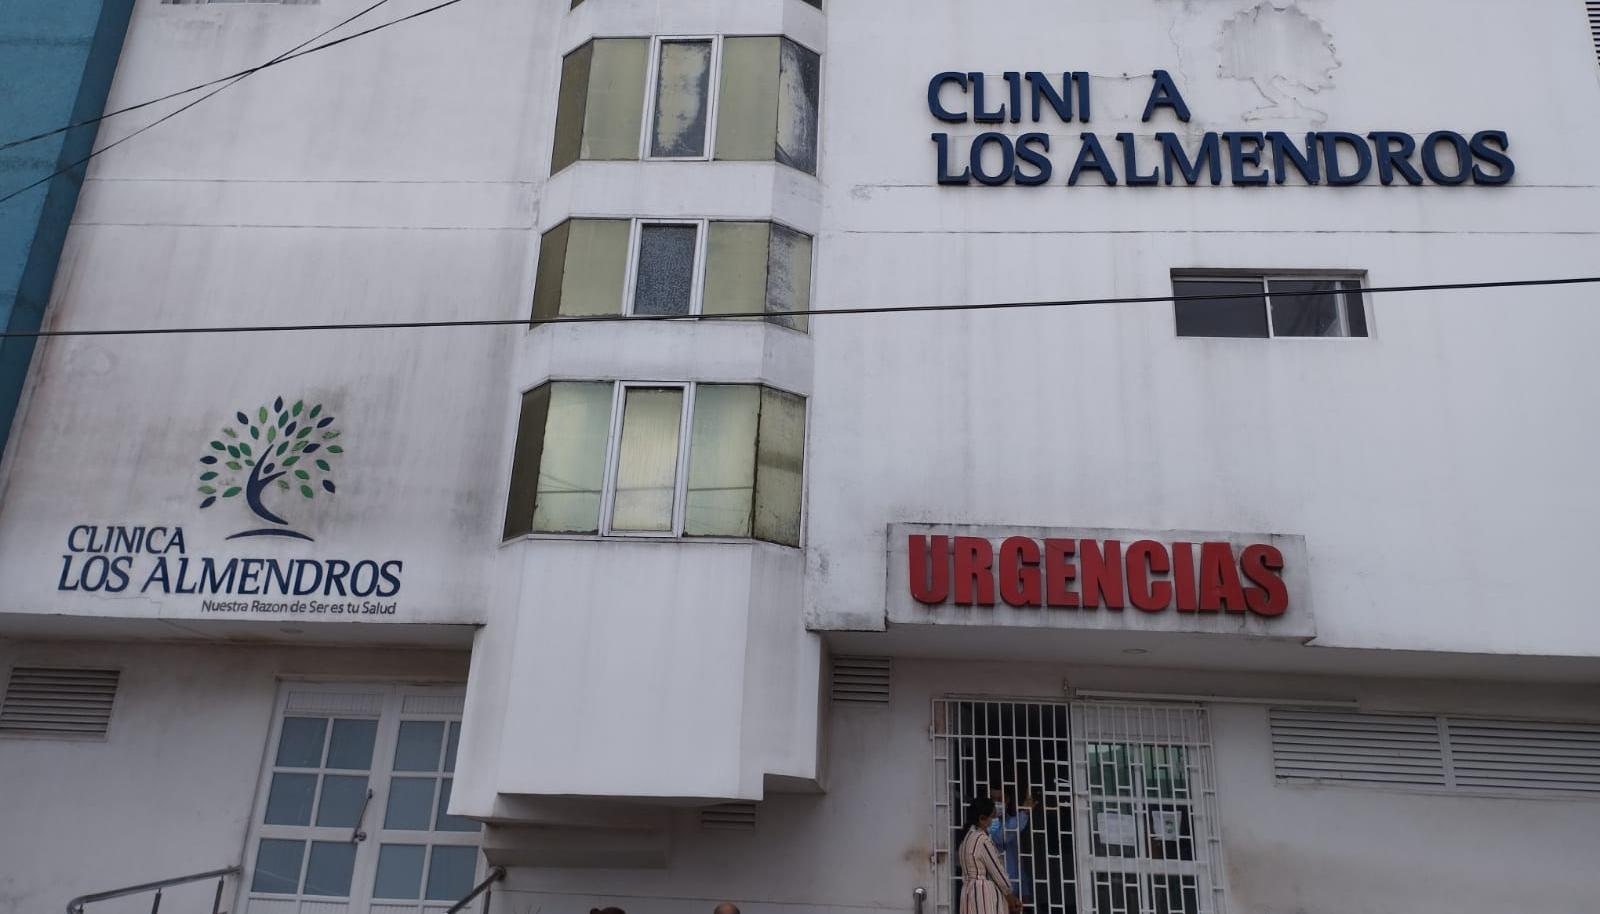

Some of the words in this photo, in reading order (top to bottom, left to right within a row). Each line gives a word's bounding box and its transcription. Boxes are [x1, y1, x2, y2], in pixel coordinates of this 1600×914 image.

[931, 132, 1053, 186] LOS
[1067, 130, 1516, 187] ALMENDROS
[67, 525, 186, 554] CLINICA
[57, 555, 133, 593] LOS
[140, 558, 403, 597] ALMENDROS
[908, 534, 1289, 617] URGENCIAS
[201, 600, 249, 613] Nuestra
[251, 600, 288, 613] Razon
[290, 600, 307, 613] de
[347, 602, 360, 614] tu
[361, 601, 397, 615] Salud
